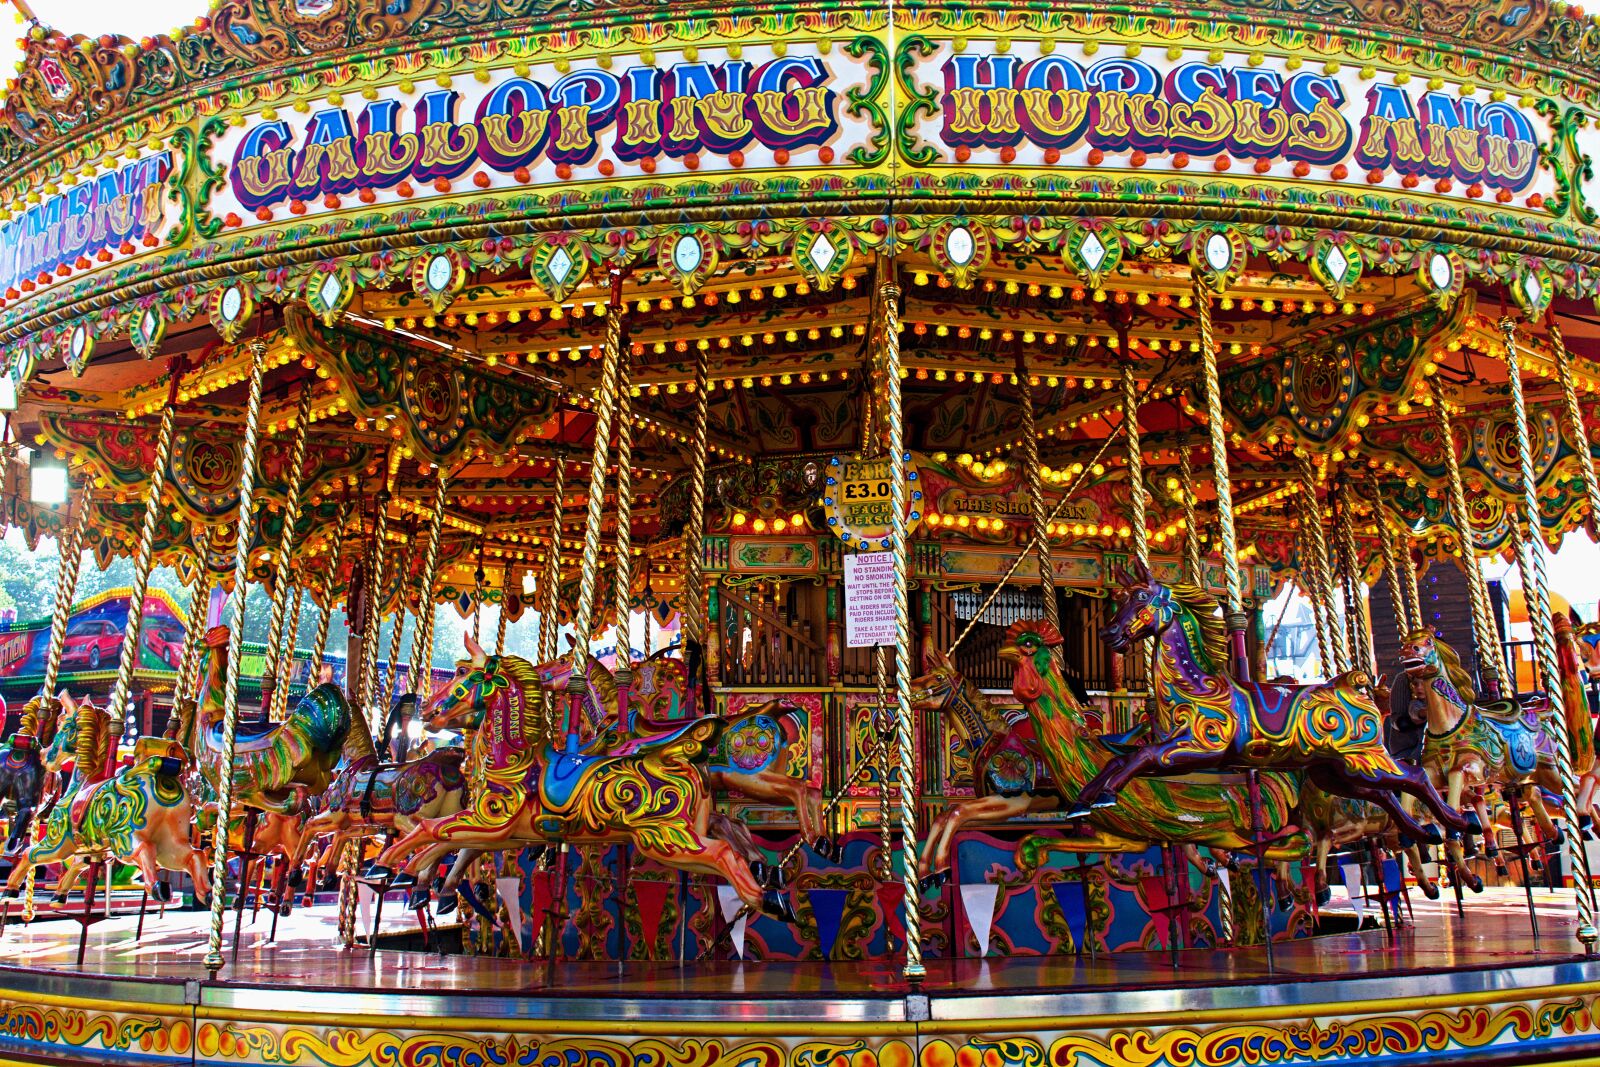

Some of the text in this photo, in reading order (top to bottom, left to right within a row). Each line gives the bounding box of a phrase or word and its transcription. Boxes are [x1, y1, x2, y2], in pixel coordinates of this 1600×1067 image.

[231, 54, 1537, 210] GALLOPING HORSES AND
[0, 149, 172, 288] YMENT
[845, 482, 890, 499] £3.0
[851, 504, 889, 515] EACH
[955, 498, 1087, 519] THE SHOAN
[845, 515, 893, 525] PERSO
[857, 555, 887, 564] NOTICE
[509, 695, 520, 740] DIONE
[953, 700, 983, 741] BARRIE
